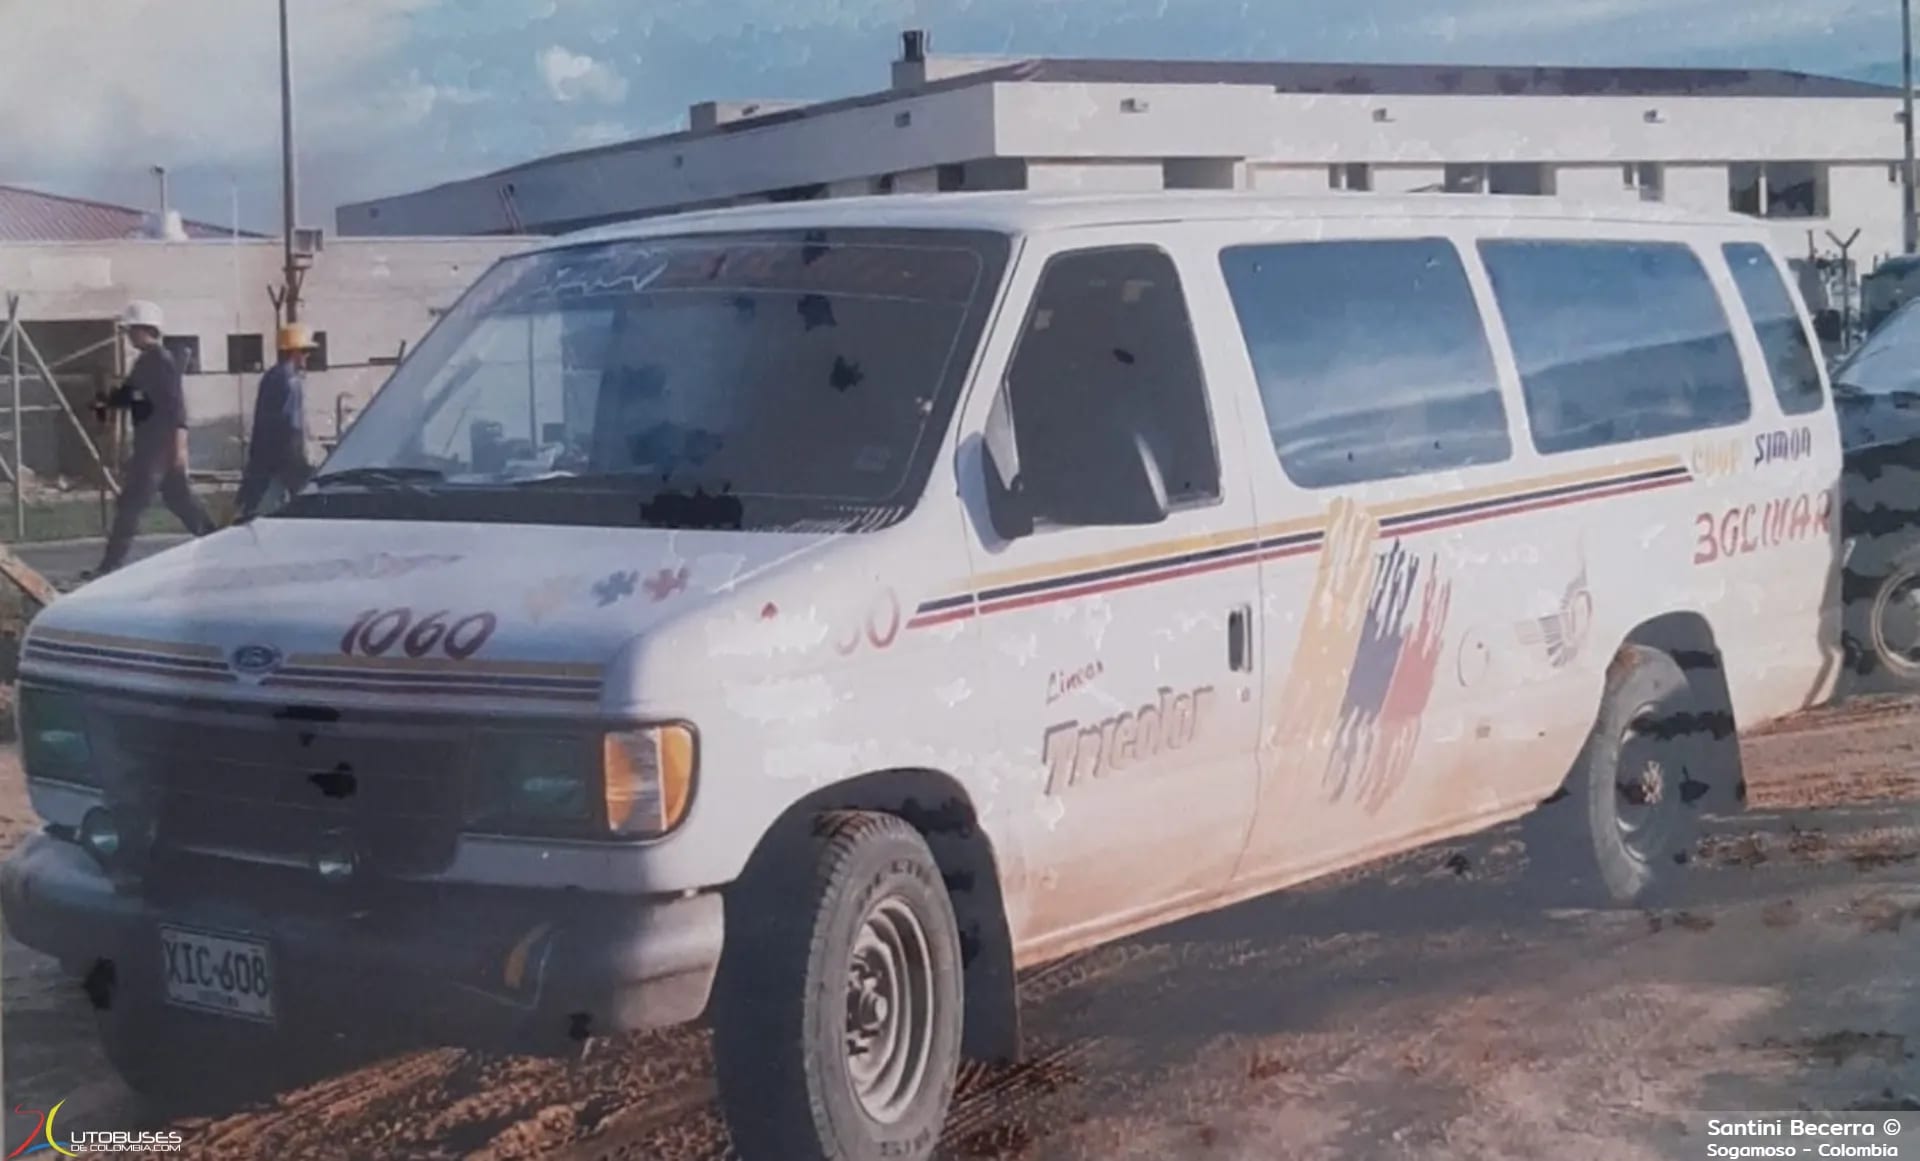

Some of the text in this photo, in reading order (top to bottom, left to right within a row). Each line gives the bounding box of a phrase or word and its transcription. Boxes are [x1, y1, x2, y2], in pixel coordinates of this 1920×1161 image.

[1754, 427, 1811, 466] SIMON
[341, 608, 497, 660] 1060
[1042, 685, 1214, 796] Tricolor
